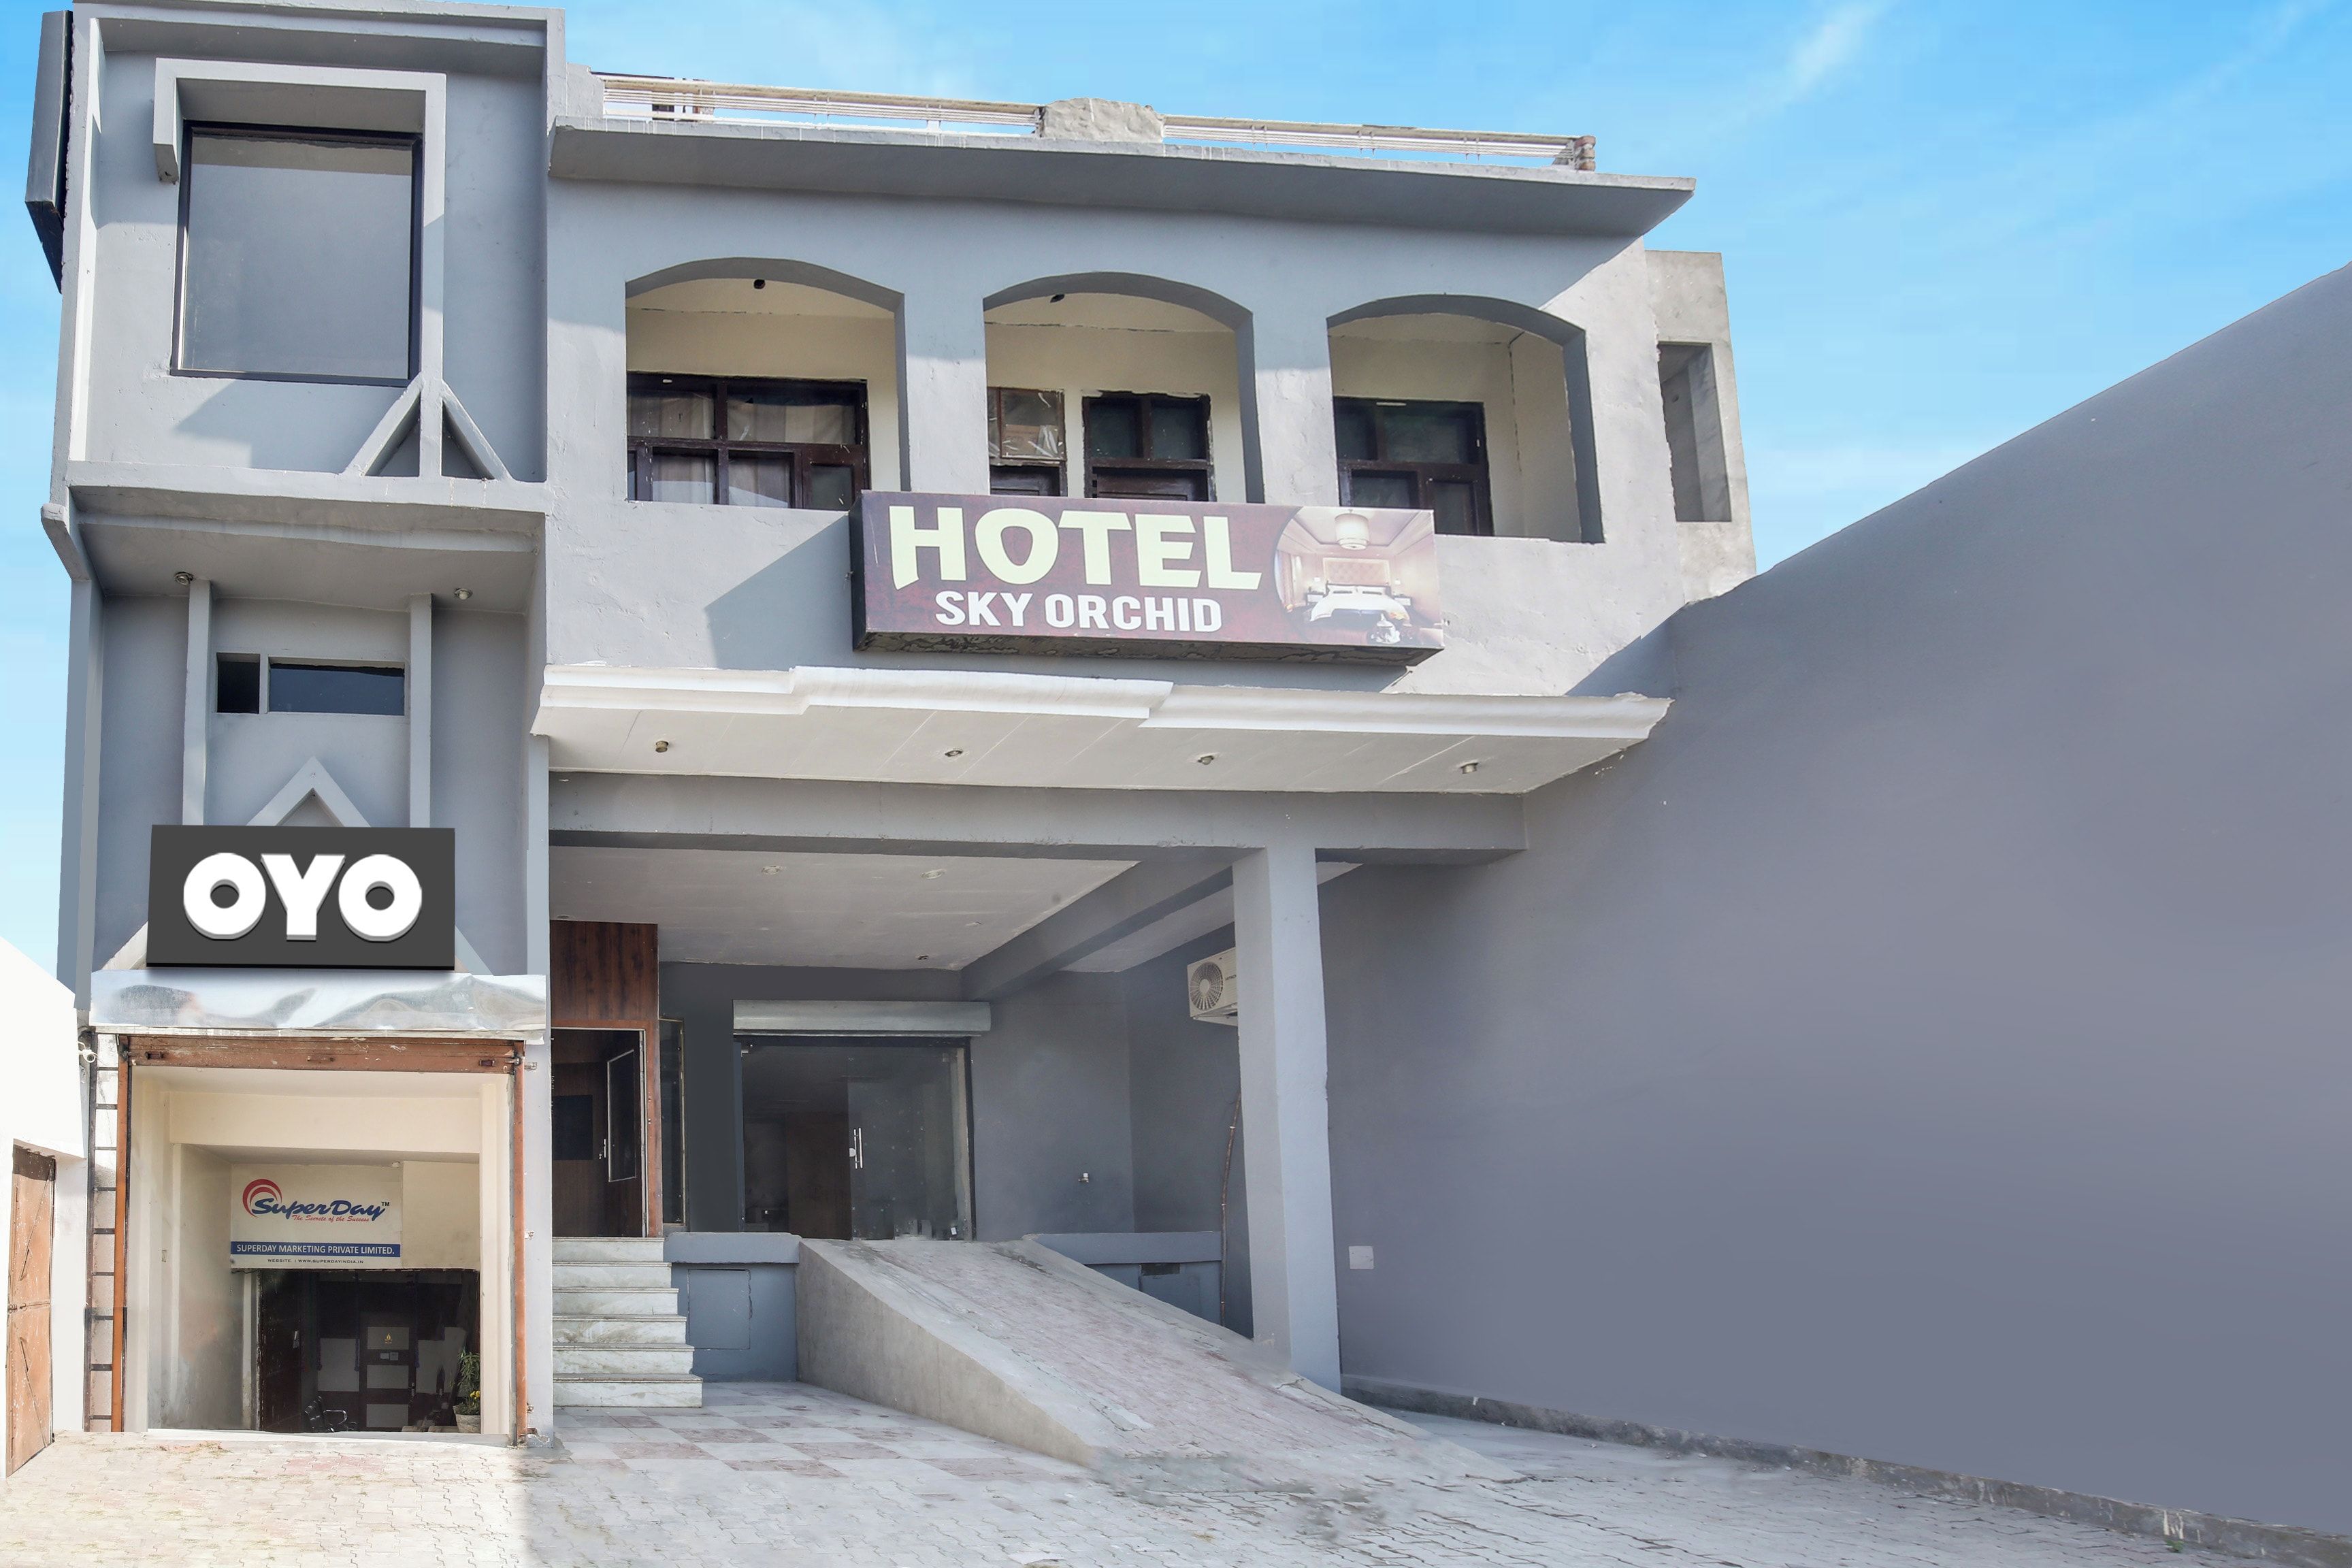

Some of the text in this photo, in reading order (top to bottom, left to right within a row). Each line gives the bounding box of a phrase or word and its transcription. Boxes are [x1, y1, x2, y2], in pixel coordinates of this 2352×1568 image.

[889, 506, 1262, 591] HOTEL
[936, 590, 1222, 632] SKY ORCHID
[183, 852, 423, 943] OYO
[252, 1198, 386, 1222] SuperDay
[237, 1244, 277, 1252] SUPERDAY
[278, 1245, 326, 1254] MARKETING
[361, 1247, 395, 1255] LIMITED.
